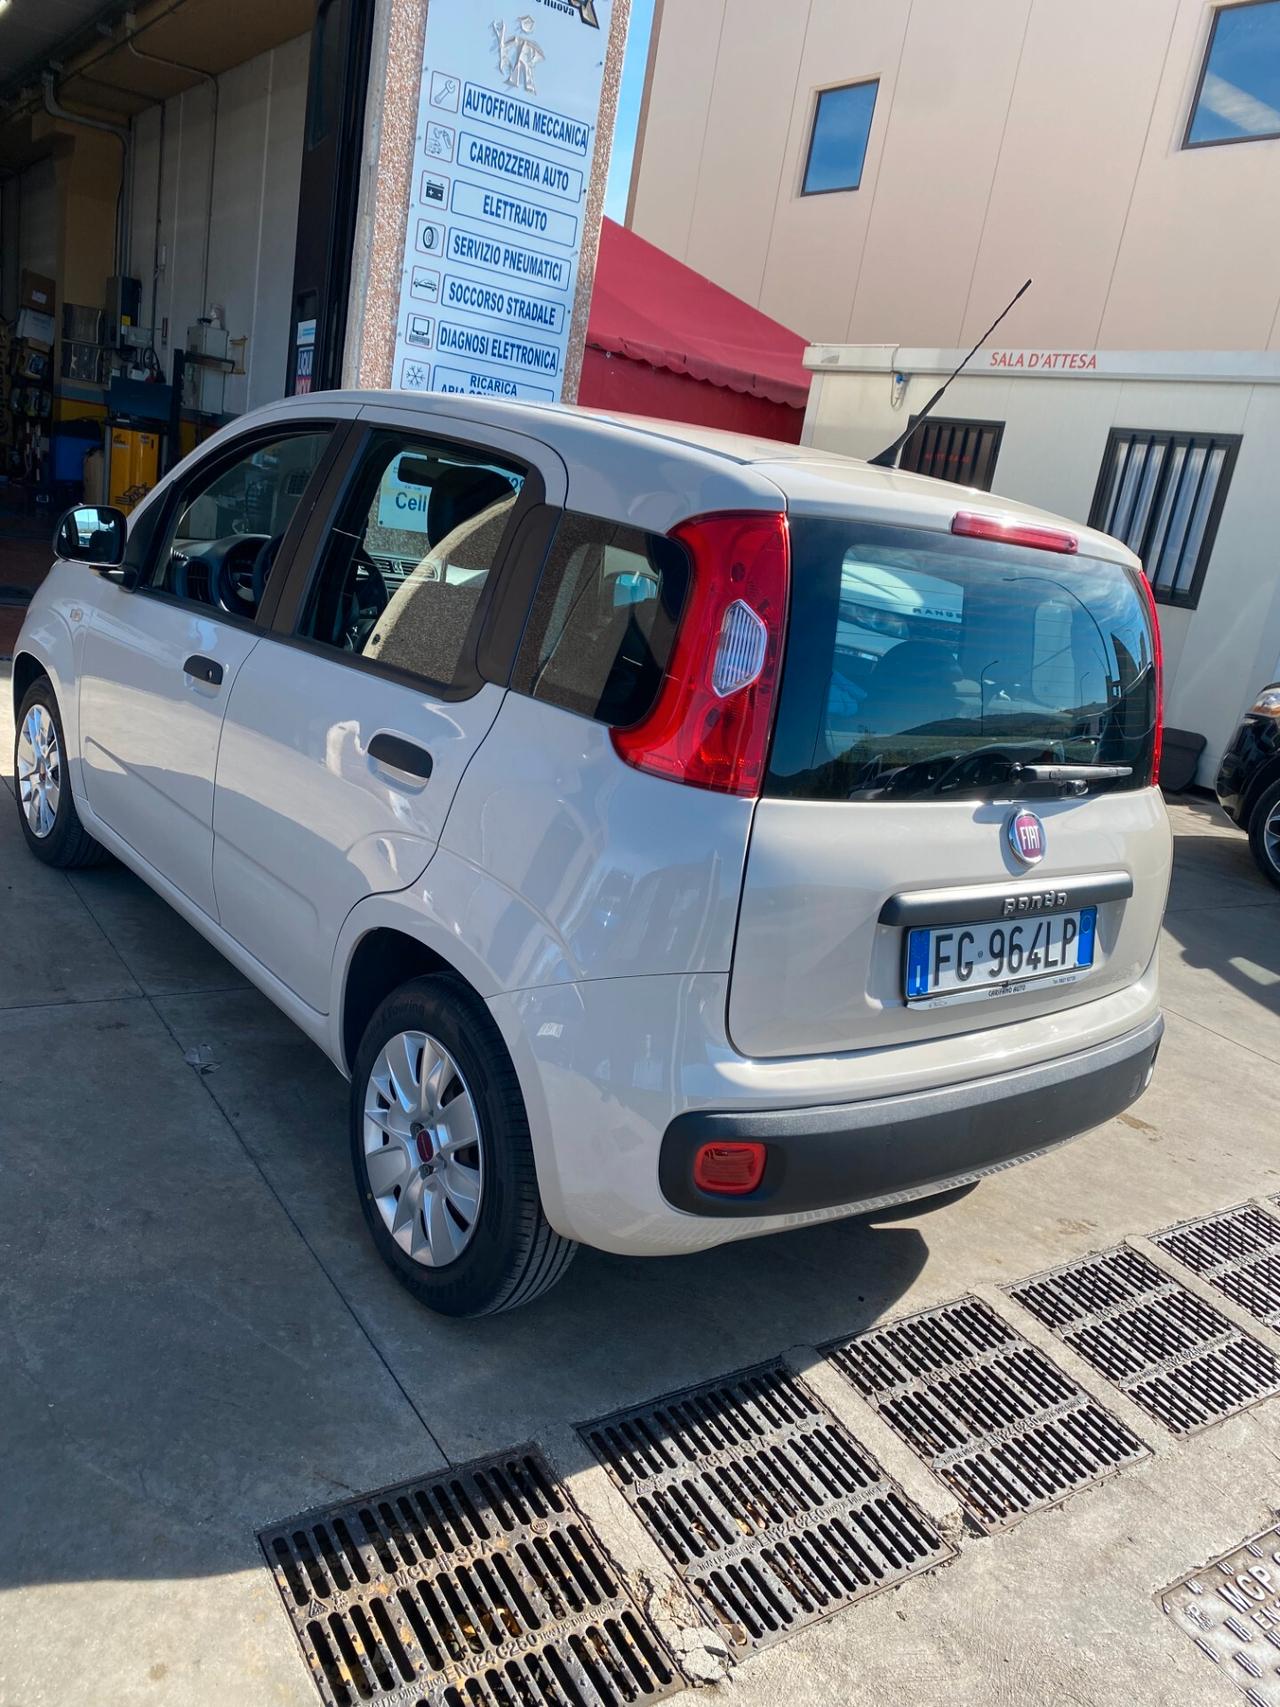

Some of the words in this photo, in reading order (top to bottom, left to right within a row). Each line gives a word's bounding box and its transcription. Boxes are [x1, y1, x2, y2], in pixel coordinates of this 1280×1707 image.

[465, 89, 530, 130] AUTOFFICINA
[532, 113, 587, 148] MECCANICA
[470, 141, 540, 183] CARROZZERIA
[542, 162, 569, 191] AUTO
[483, 195, 547, 232] ELETTRAUTO
[453, 235, 501, 265] SERVIZIO
[503, 251, 562, 282] PNEUMATICI
[449, 283, 504, 312] SOCCORSO
[506, 299, 556, 326] STRADALE
[440, 327, 488, 355] DIAGNOSI
[491, 339, 556, 370] ELETTRONICA
[990, 352, 1024, 368] SALA
[1027, 352, 1097, 369] D'ATTESA
[470, 375, 517, 396] RICARICA
[1020, 826, 1040, 850] FIAT
[1004, 890, 1068, 915] panda
[933, 931, 975, 986] FG
[988, 917, 1077, 978] 964LP
[393, 1559, 433, 1587] MCP
[457, 1540, 494, 1563] SPA
[1216, 1565, 1278, 1614] MCP
[443, 1650, 497, 1685] EN124
[496, 1632, 539, 1659] C250
